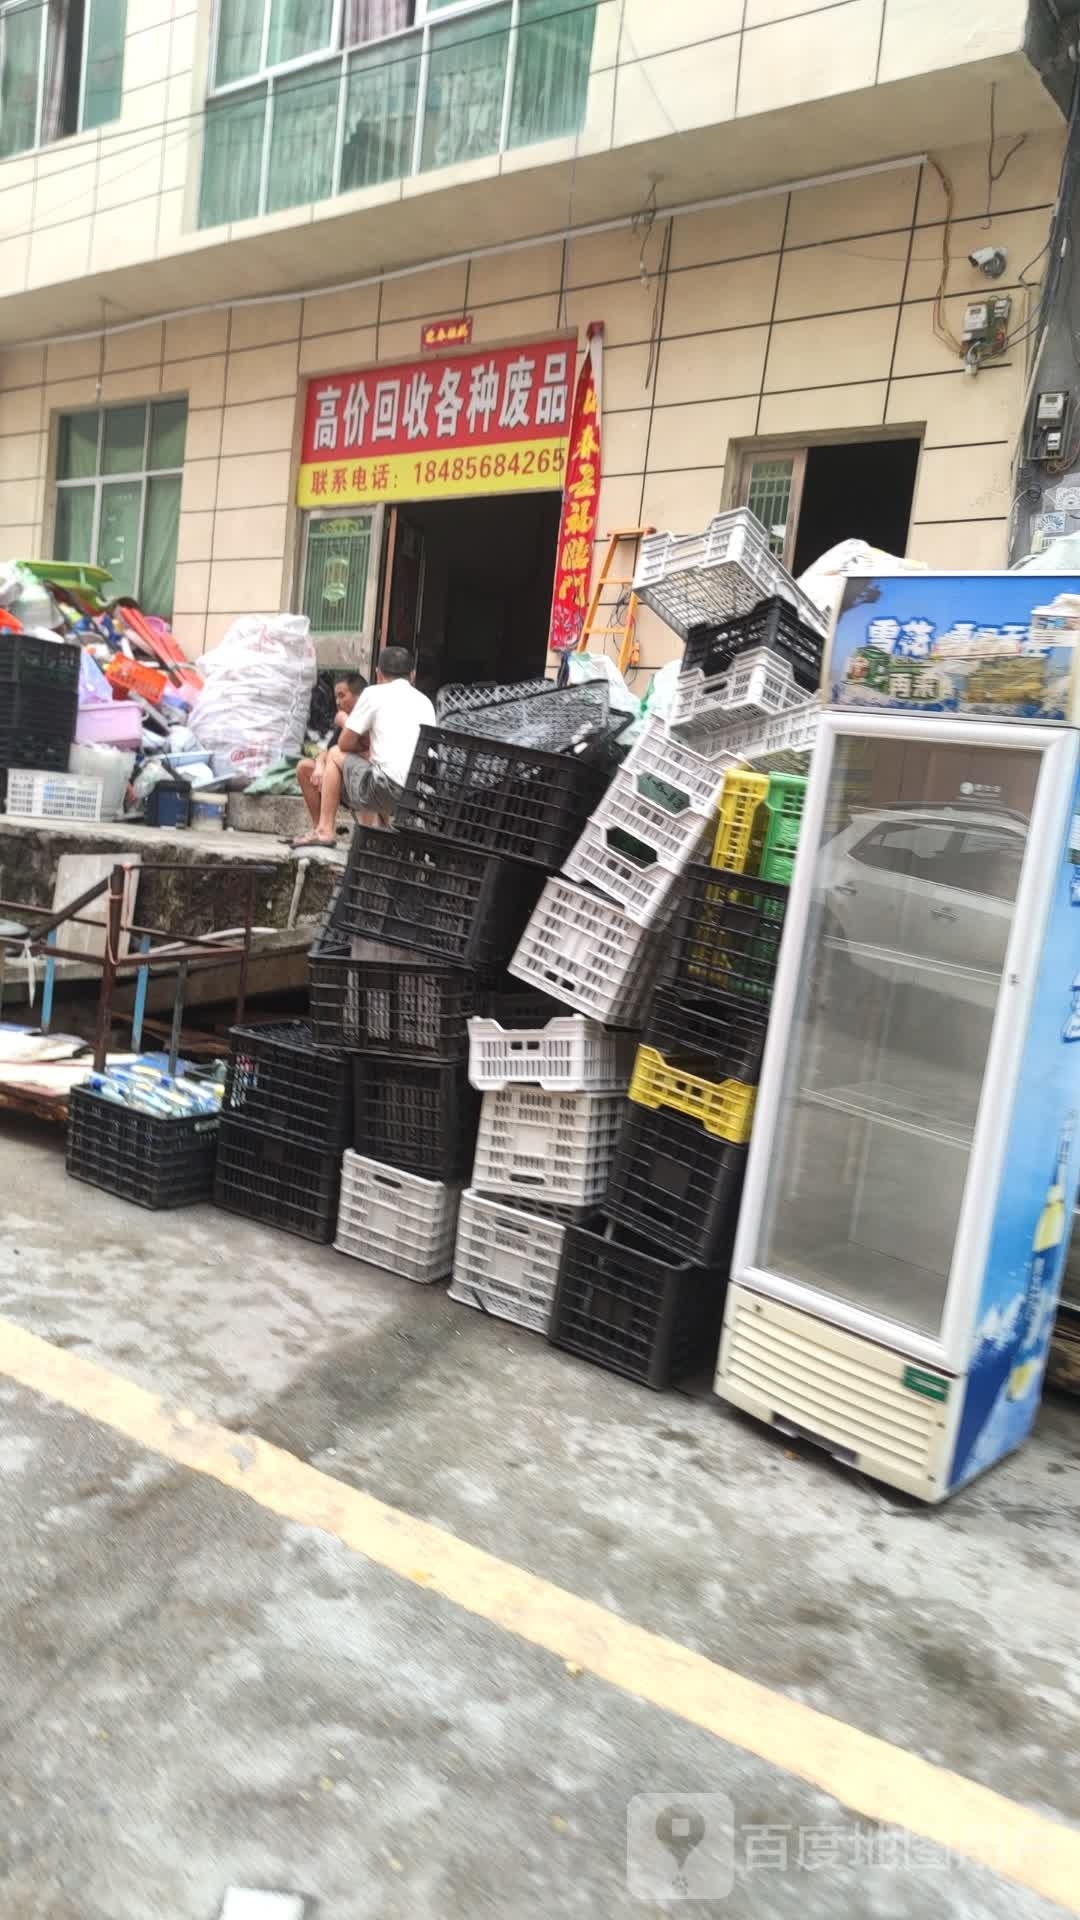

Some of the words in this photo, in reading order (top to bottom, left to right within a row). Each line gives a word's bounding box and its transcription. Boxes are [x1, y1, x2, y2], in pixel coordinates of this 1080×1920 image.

[313, 352, 568, 451] 高价回收各种废品
[414, 447, 565, 485] 18485684265
